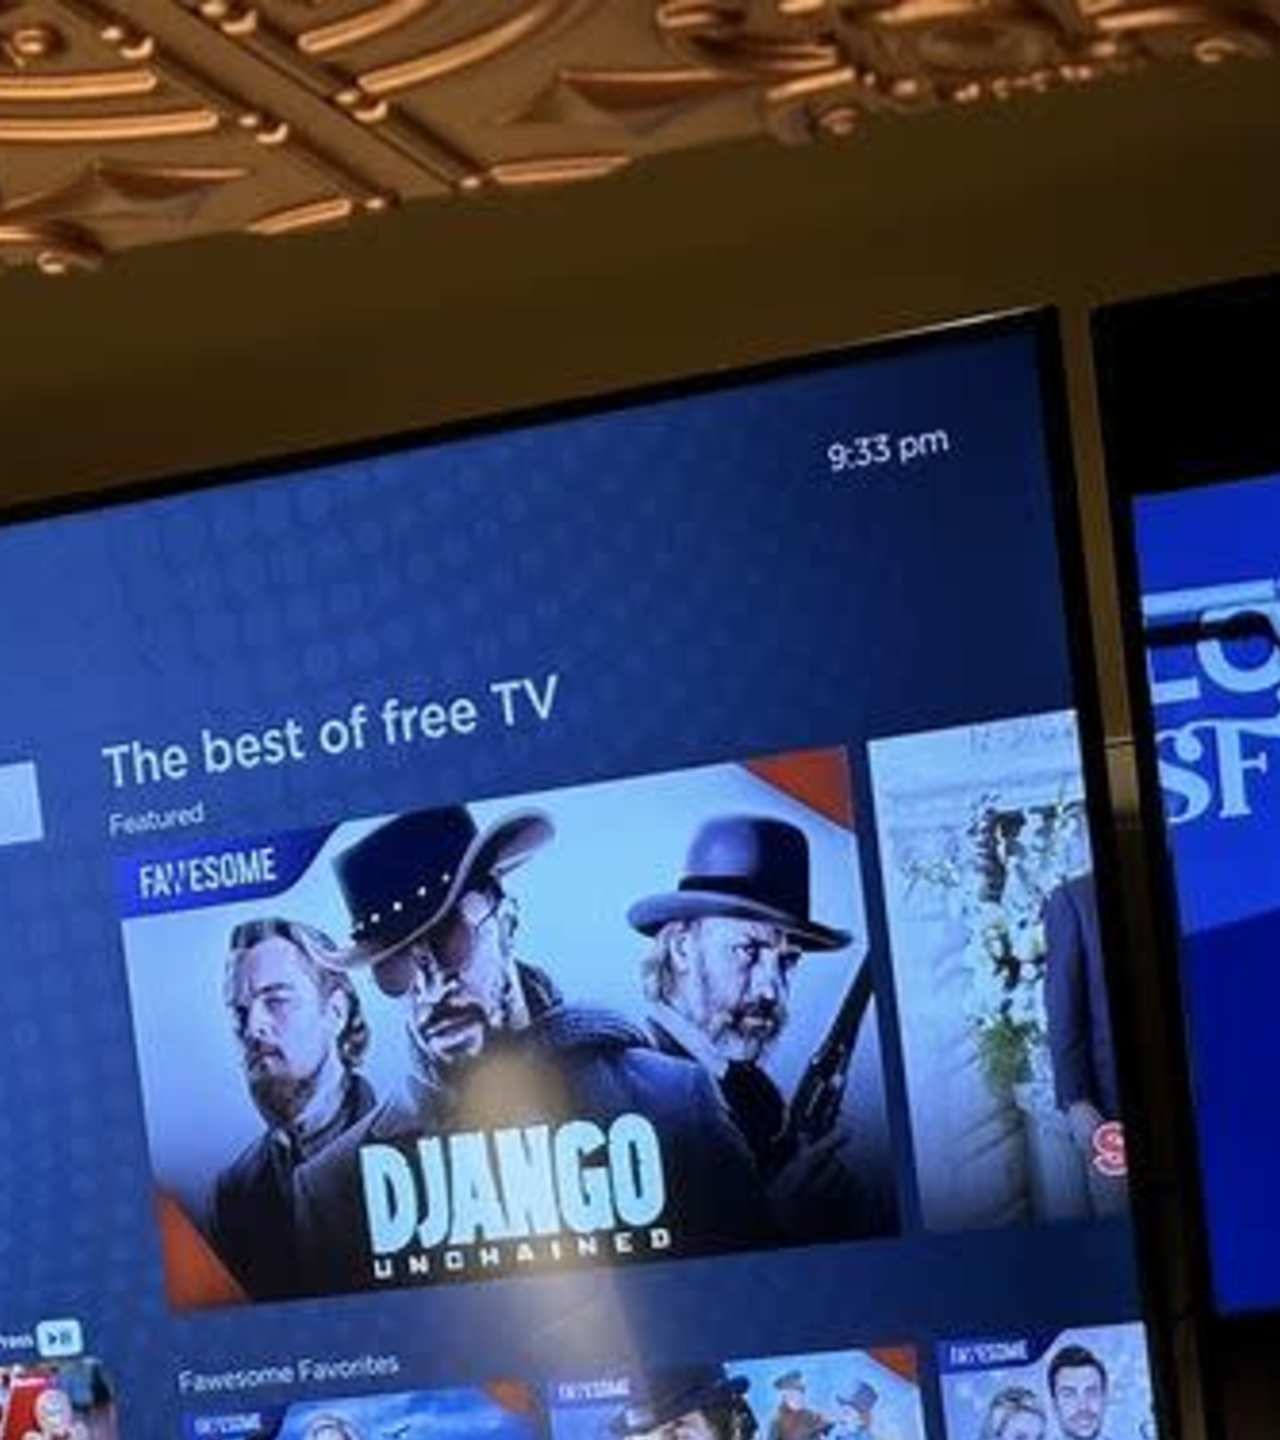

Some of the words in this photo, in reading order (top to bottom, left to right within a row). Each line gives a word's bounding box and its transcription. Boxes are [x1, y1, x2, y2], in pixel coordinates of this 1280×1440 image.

[827, 432, 891, 472] 9:33
[899, 428, 949, 465] pm
[102, 740, 188, 788] The
[201, 718, 305, 774] best
[320, 703, 370, 755] of
[380, 697, 478, 745] free
[490, 674, 560, 726] TV
[109, 801, 205, 838] Featured
[359, 1112, 667, 1256] DJANGO
[373, 1227, 672, 1280] UNCHAINED
[178, 1364, 295, 1395] Fawesome
[297, 1352, 401, 1383] Favorites
